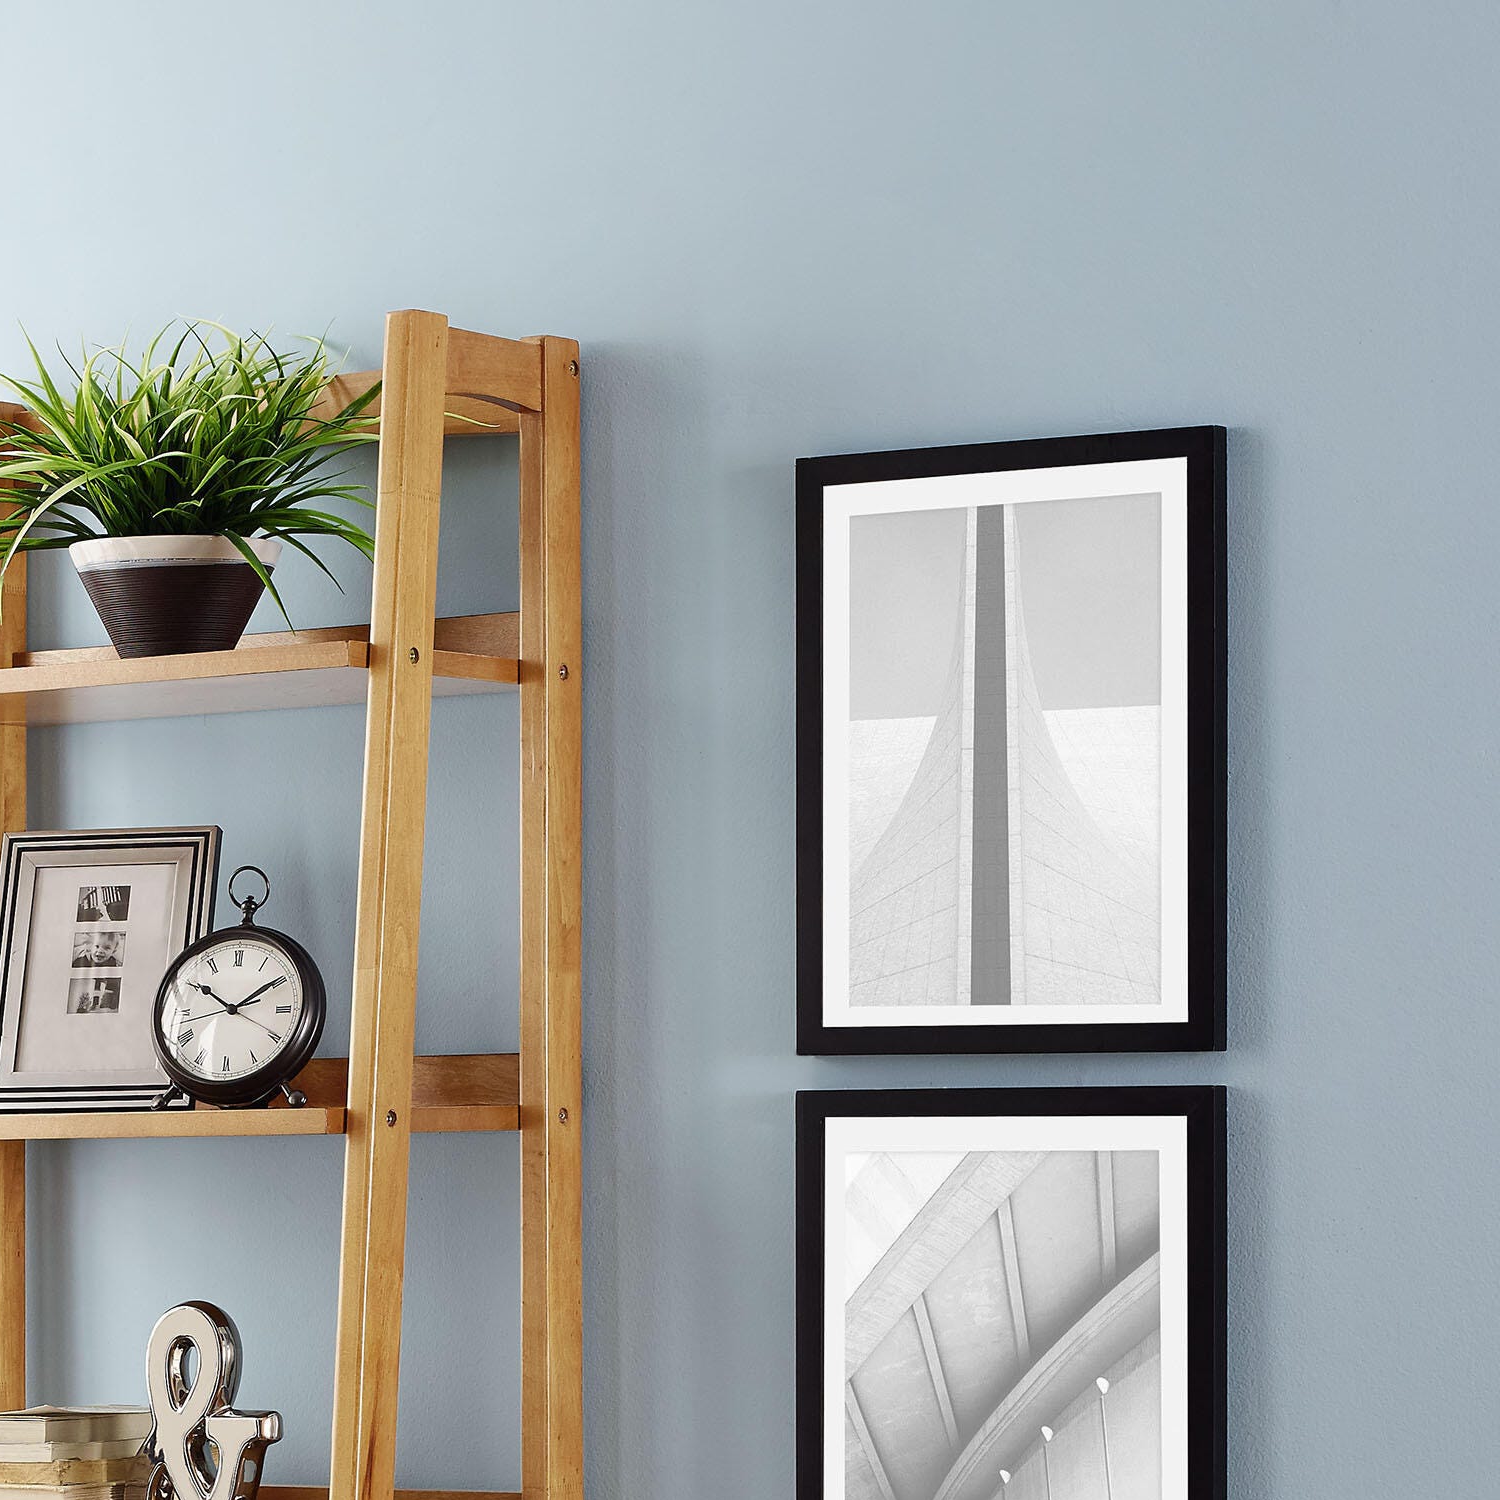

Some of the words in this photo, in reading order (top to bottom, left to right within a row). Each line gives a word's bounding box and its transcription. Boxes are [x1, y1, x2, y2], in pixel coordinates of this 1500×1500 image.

[206, 958, 219, 975] XI
[233, 950, 244, 967] XII
[258, 957, 269, 972] I
[275, 1005, 292, 1014] III
[249, 1049, 258, 1065] V
